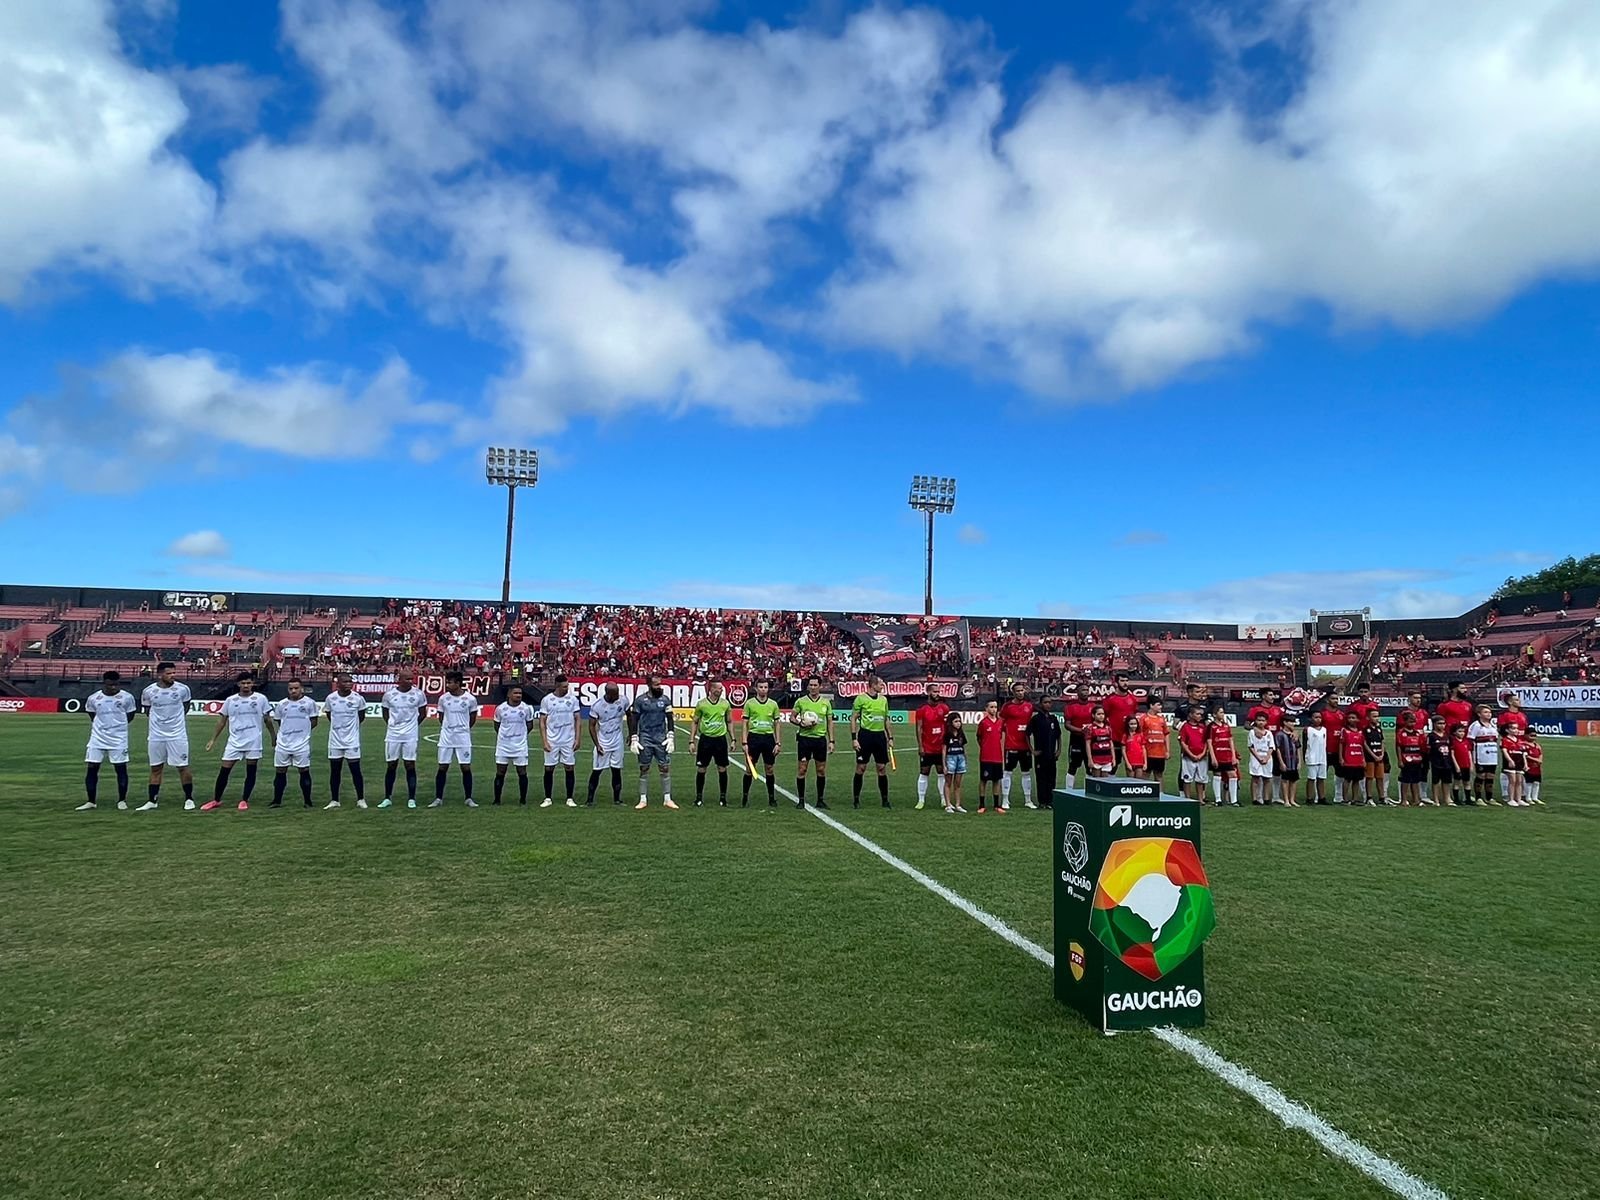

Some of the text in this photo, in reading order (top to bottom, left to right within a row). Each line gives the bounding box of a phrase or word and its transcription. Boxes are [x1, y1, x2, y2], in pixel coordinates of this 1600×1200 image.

[350, 674, 399, 683] SQUADRÃ
[417, 675, 490, 696] JOEM
[567, 680, 726, 708] ESUARÃ
[838, 681, 887, 697] COMAO
[1544, 688, 1576, 702] ZONA
[1120, 785, 1153, 794] GAUCHÃO
[1135, 814, 1192, 830] Ipiranga
[1061, 870, 1092, 891] GAUCHÃO
[1107, 985, 1202, 1012] GAUCHÃO
